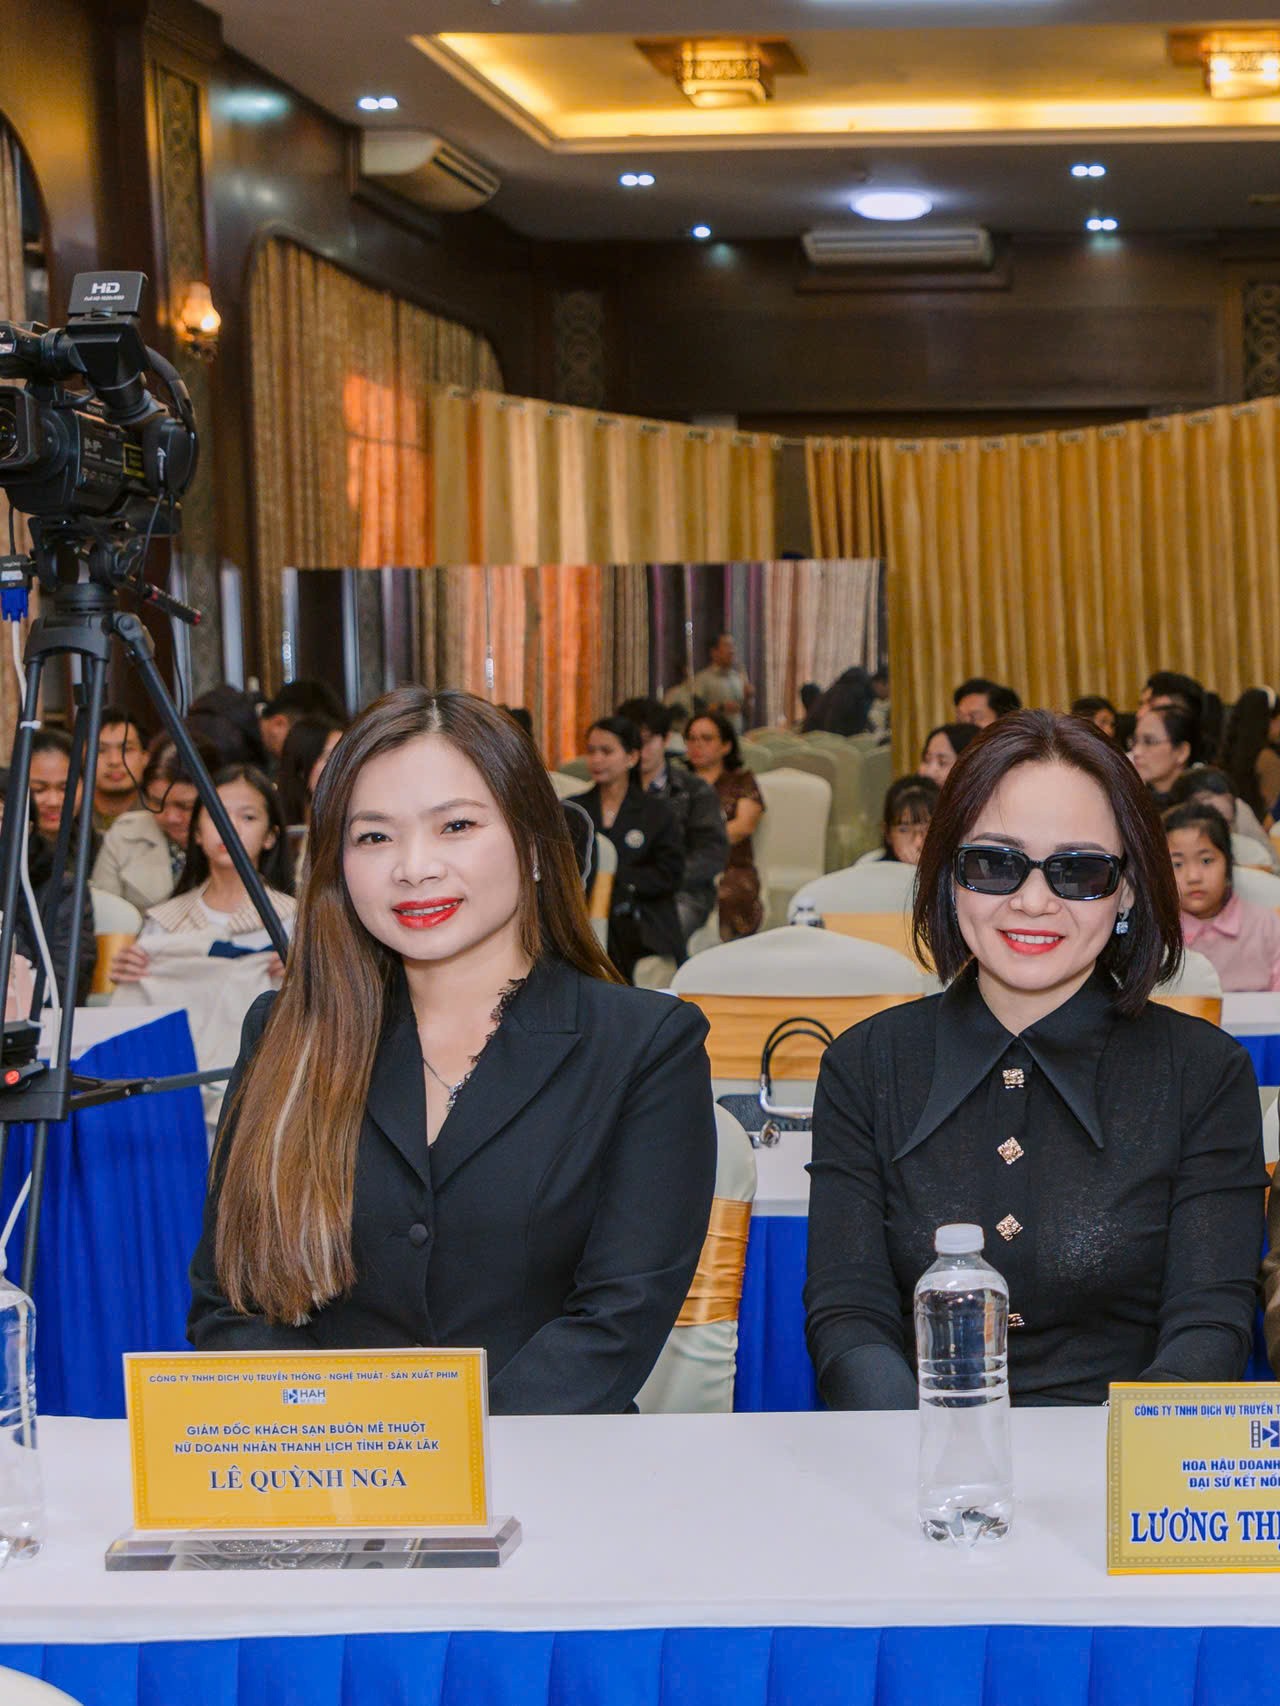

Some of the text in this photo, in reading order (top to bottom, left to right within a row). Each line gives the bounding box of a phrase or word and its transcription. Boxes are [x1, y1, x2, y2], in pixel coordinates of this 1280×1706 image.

[91, 282, 121, 294] HD
[150, 1374, 177, 1383] CÔNG
[218, 1374, 240, 1383] DỊCH
[243, 1374, 254, 1383] VỤ
[257, 1371, 288, 1382] TRUYỀN
[291, 1373, 322, 1381] THÔNG
[330, 1372, 353, 1381] NGHỆ
[357, 1372, 383, 1381] THUẬT
[412, 1370, 434, 1379] XUẤT
[300, 1389, 326, 1398] HAH
[1135, 1404, 1159, 1416] CÔNG
[1162, 1406, 1172, 1416] TY
[1175, 1405, 1198, 1416] TNHH
[1201, 1405, 1222, 1417] DỊCH
[1225, 1405, 1236, 1417] VỤ
[1239, 1402, 1273, 1415] TRUYỀN
[187, 1422, 426, 1437] GIÁM ĐỐC KHÁCH SẠN BUÔN MÊ THUỘT
[175, 1442, 192, 1453] NỮ
[195, 1444, 239, 1453] DOANH
[243, 1441, 277, 1452] NHÂN
[281, 1442, 321, 1452] THANH
[326, 1441, 353, 1454] LỊCH
[1183, 1461, 1207, 1471] HOA
[1211, 1459, 1235, 1472] HẬU
[1239, 1460, 1280, 1470] DOANH
[210, 1465, 407, 1492] LÊ QUỲNH NGA
[1190, 1478, 1210, 1490] ĐẠI
[1214, 1475, 1231, 1488] SỨ
[1234, 1473, 1257, 1487] KẾT
[1260, 1473, 1280, 1487] NỐI
[1131, 1507, 1229, 1542] LƯƠNG
